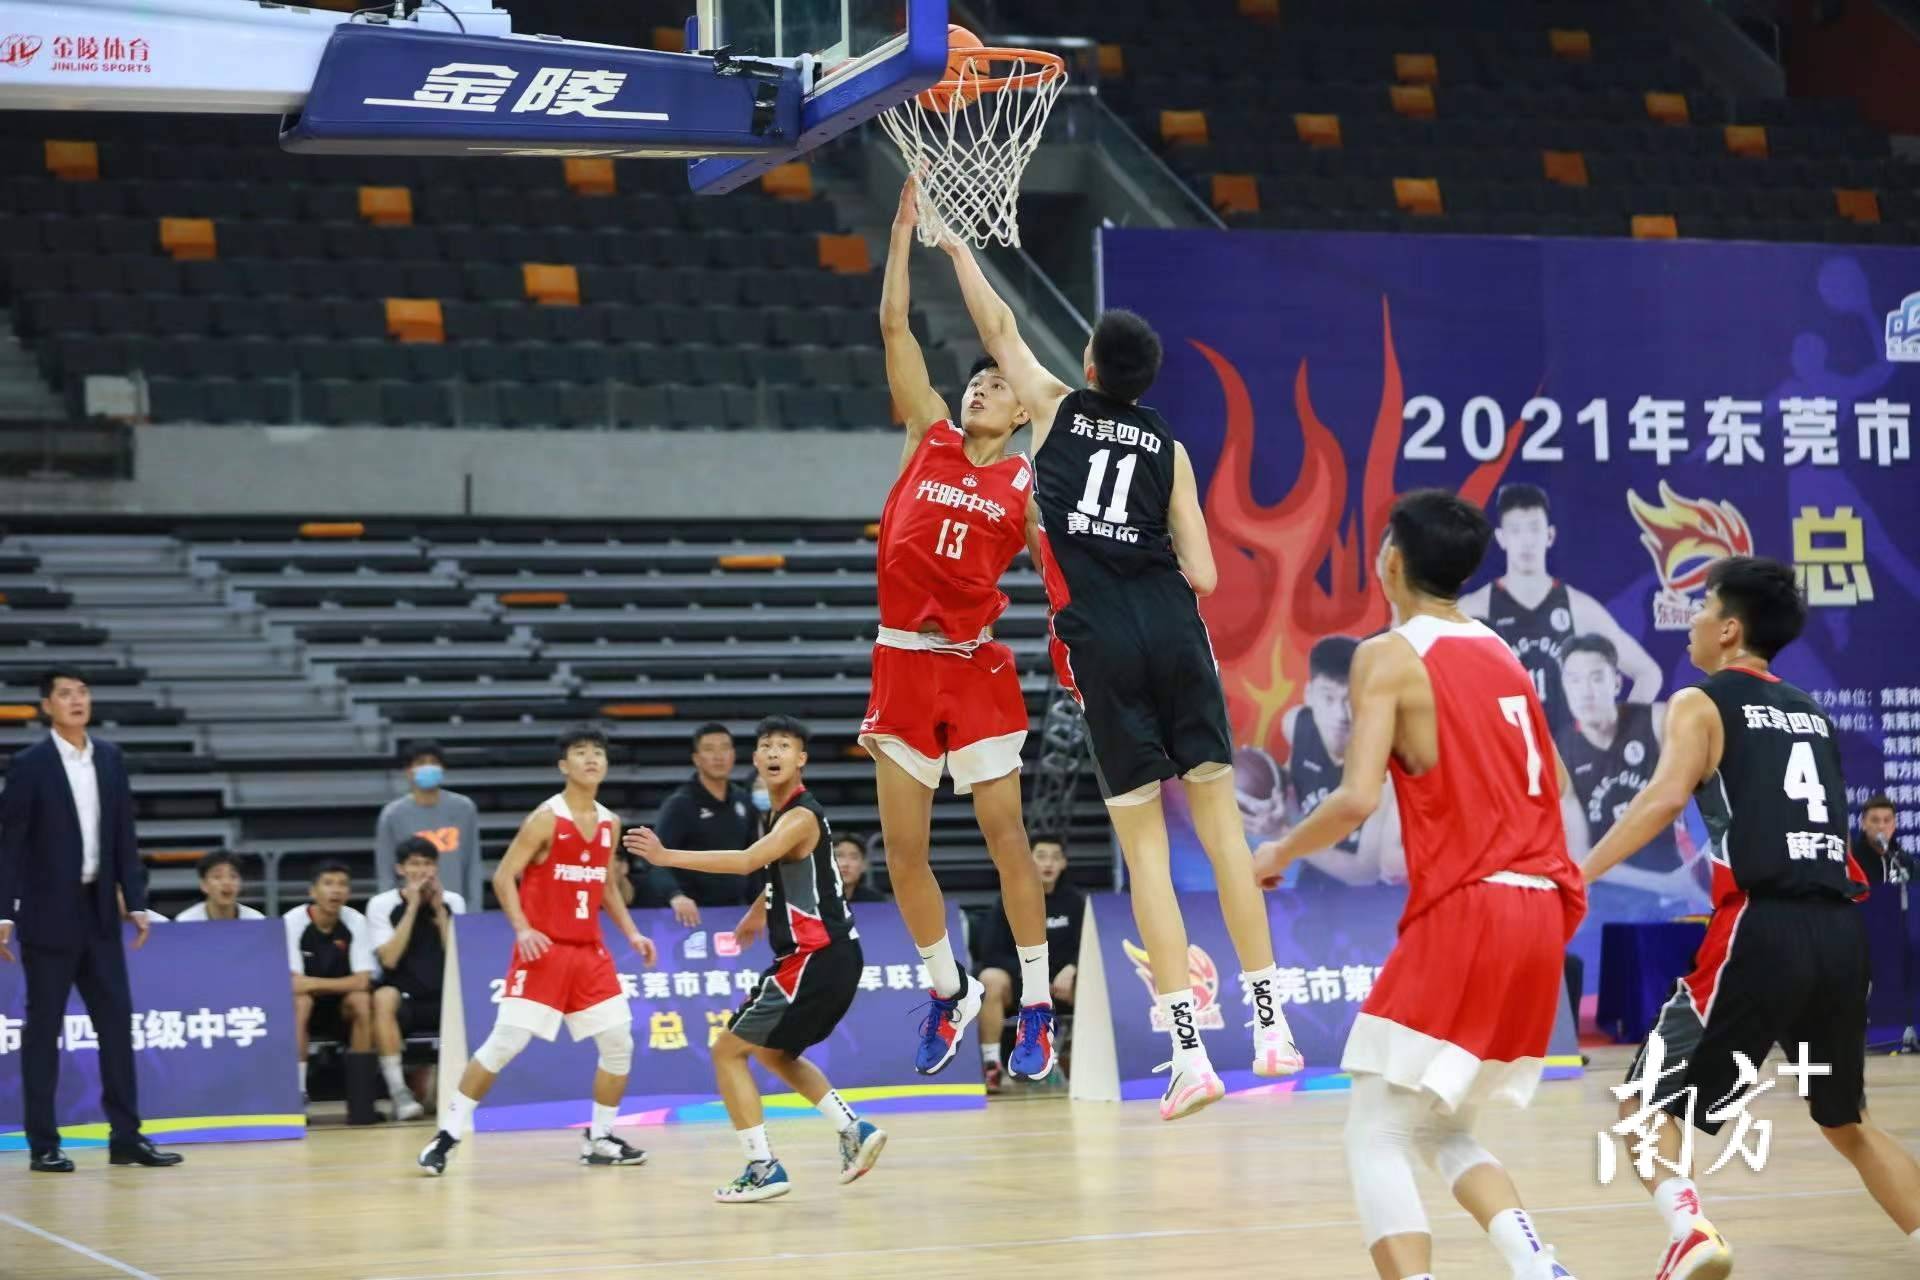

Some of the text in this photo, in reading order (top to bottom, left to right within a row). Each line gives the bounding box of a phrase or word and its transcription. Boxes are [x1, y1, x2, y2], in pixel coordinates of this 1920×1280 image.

[51, 62, 151, 73] JINLING SPORTS
[53, 36, 150, 61] 金陵体育
[363, 62, 669, 121] 金陵
[1070, 413, 1162, 454] 东莞四中
[1402, 396, 1911, 466] 2021年东莞市
[916, 480, 1006, 523] 光明中学
[1077, 448, 1138, 524] 11
[934, 518, 970, 560] 13
[1792, 506, 1874, 606] 总
[1742, 704, 1829, 738] 东莞四中
[1498, 695, 1542, 794] 7
[1784, 742, 1829, 823] 4
[576, 890, 589, 919] 3
